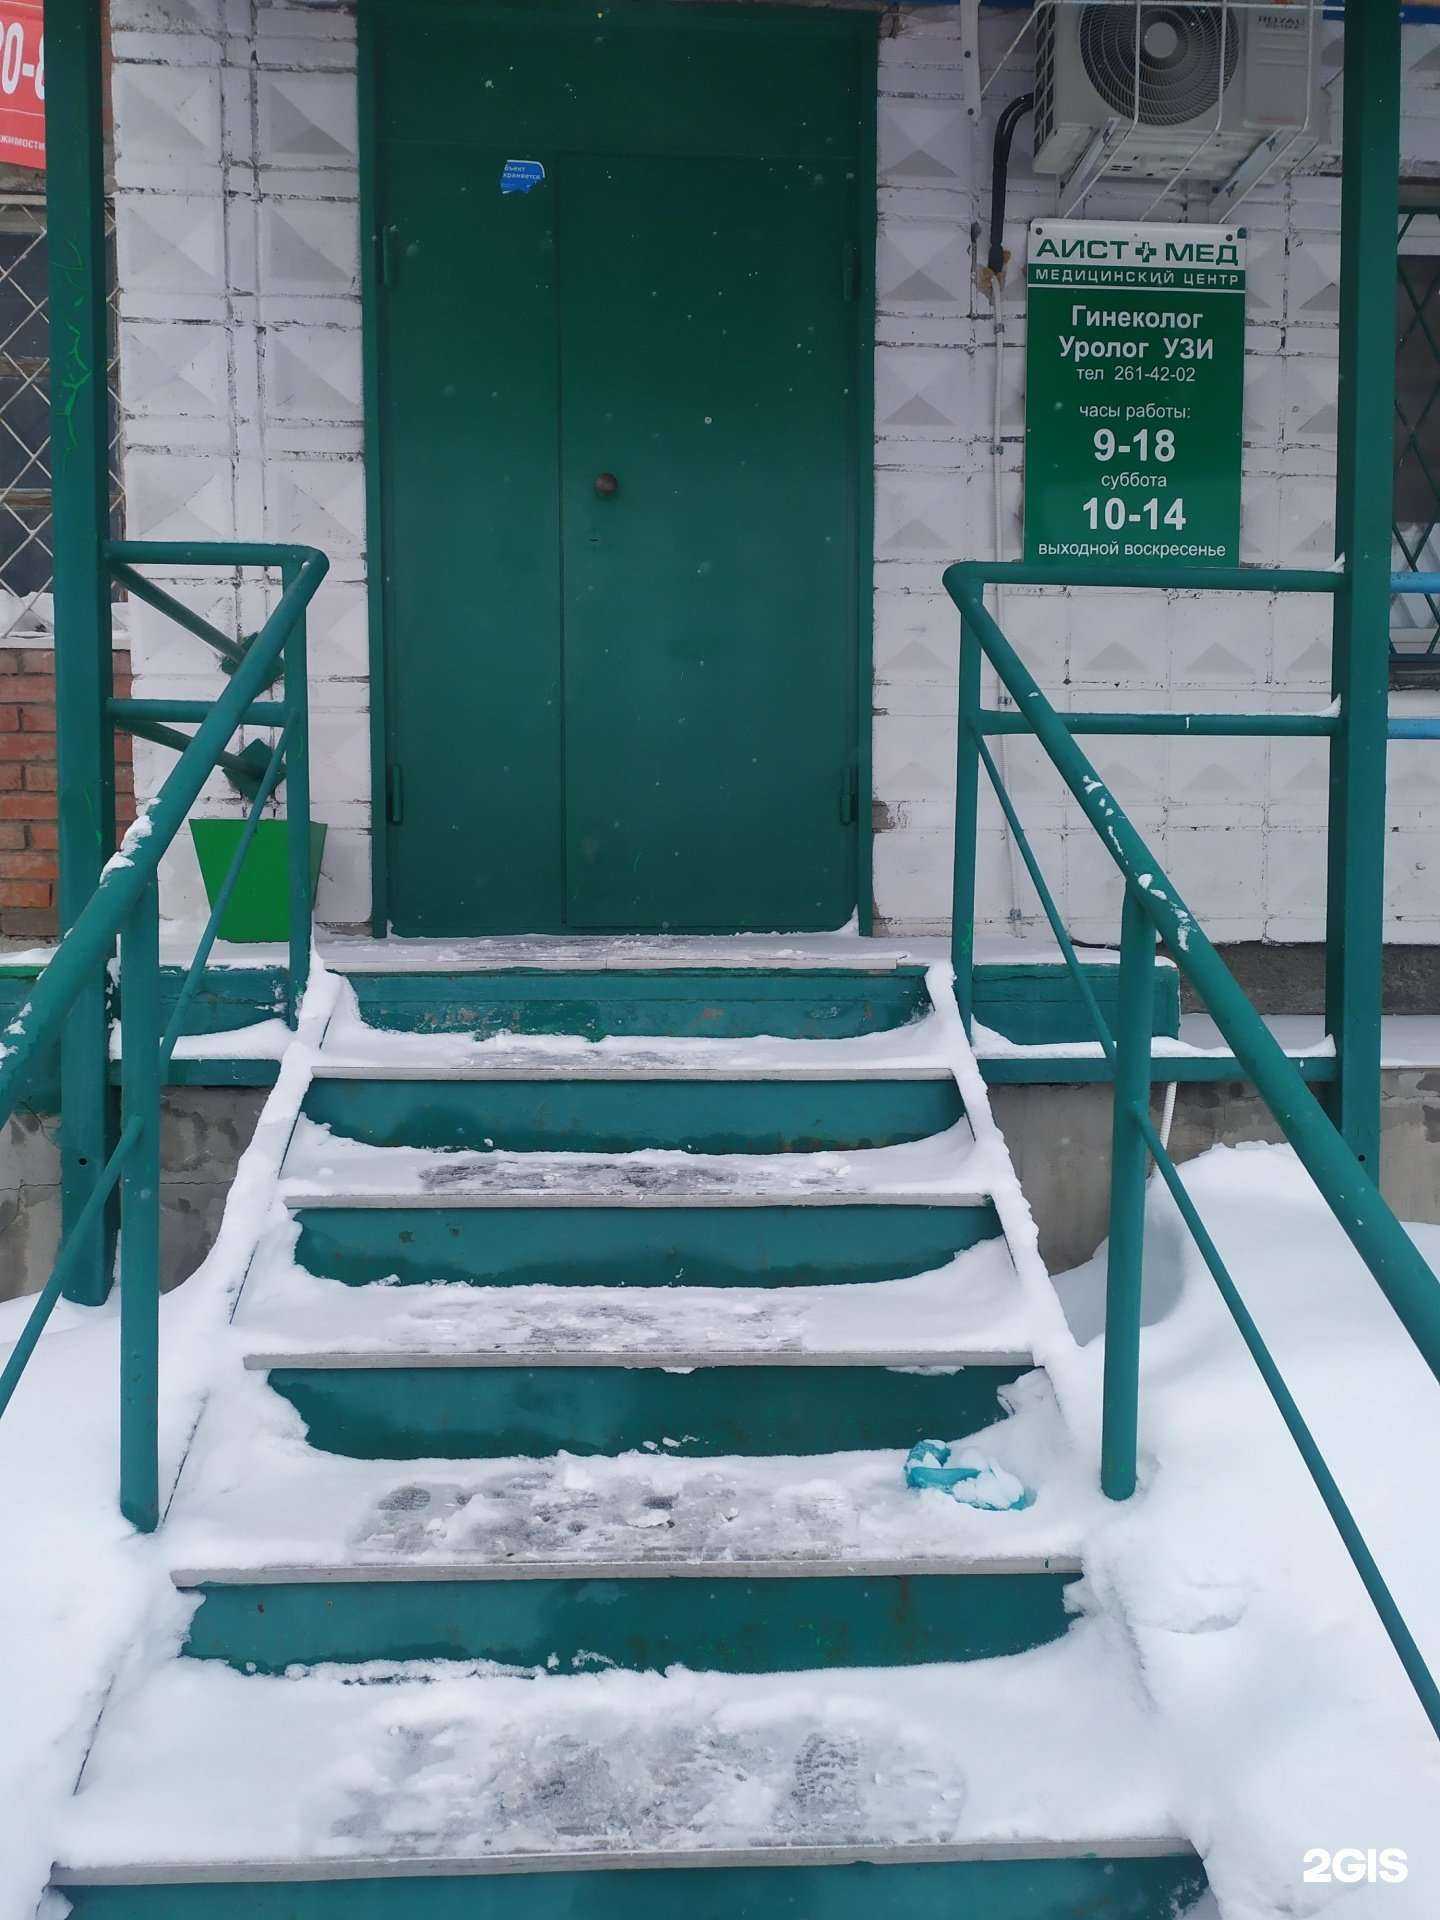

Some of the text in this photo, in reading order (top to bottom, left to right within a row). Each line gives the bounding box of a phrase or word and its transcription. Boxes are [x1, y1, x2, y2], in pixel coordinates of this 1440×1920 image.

[1036, 238, 1239, 266] АИСТ МЕД
[1035, 268, 1239, 286] МЕДИЦИНСКИЙ ЦЕНТР
[1071, 304, 1204, 329] Гинеколог
[1058, 335, 1214, 362] Уролог УЗИ
[1076, 365, 1196, 382] тел 261-42-02
[1079, 403, 1191, 421] часы работы:
[1093, 428, 1176, 463] 9-18
[1101, 471, 1167, 490] суббота
[1082, 497, 1187, 531] 10-14
[1038, 539, 1226, 559] выходной воскресенье
